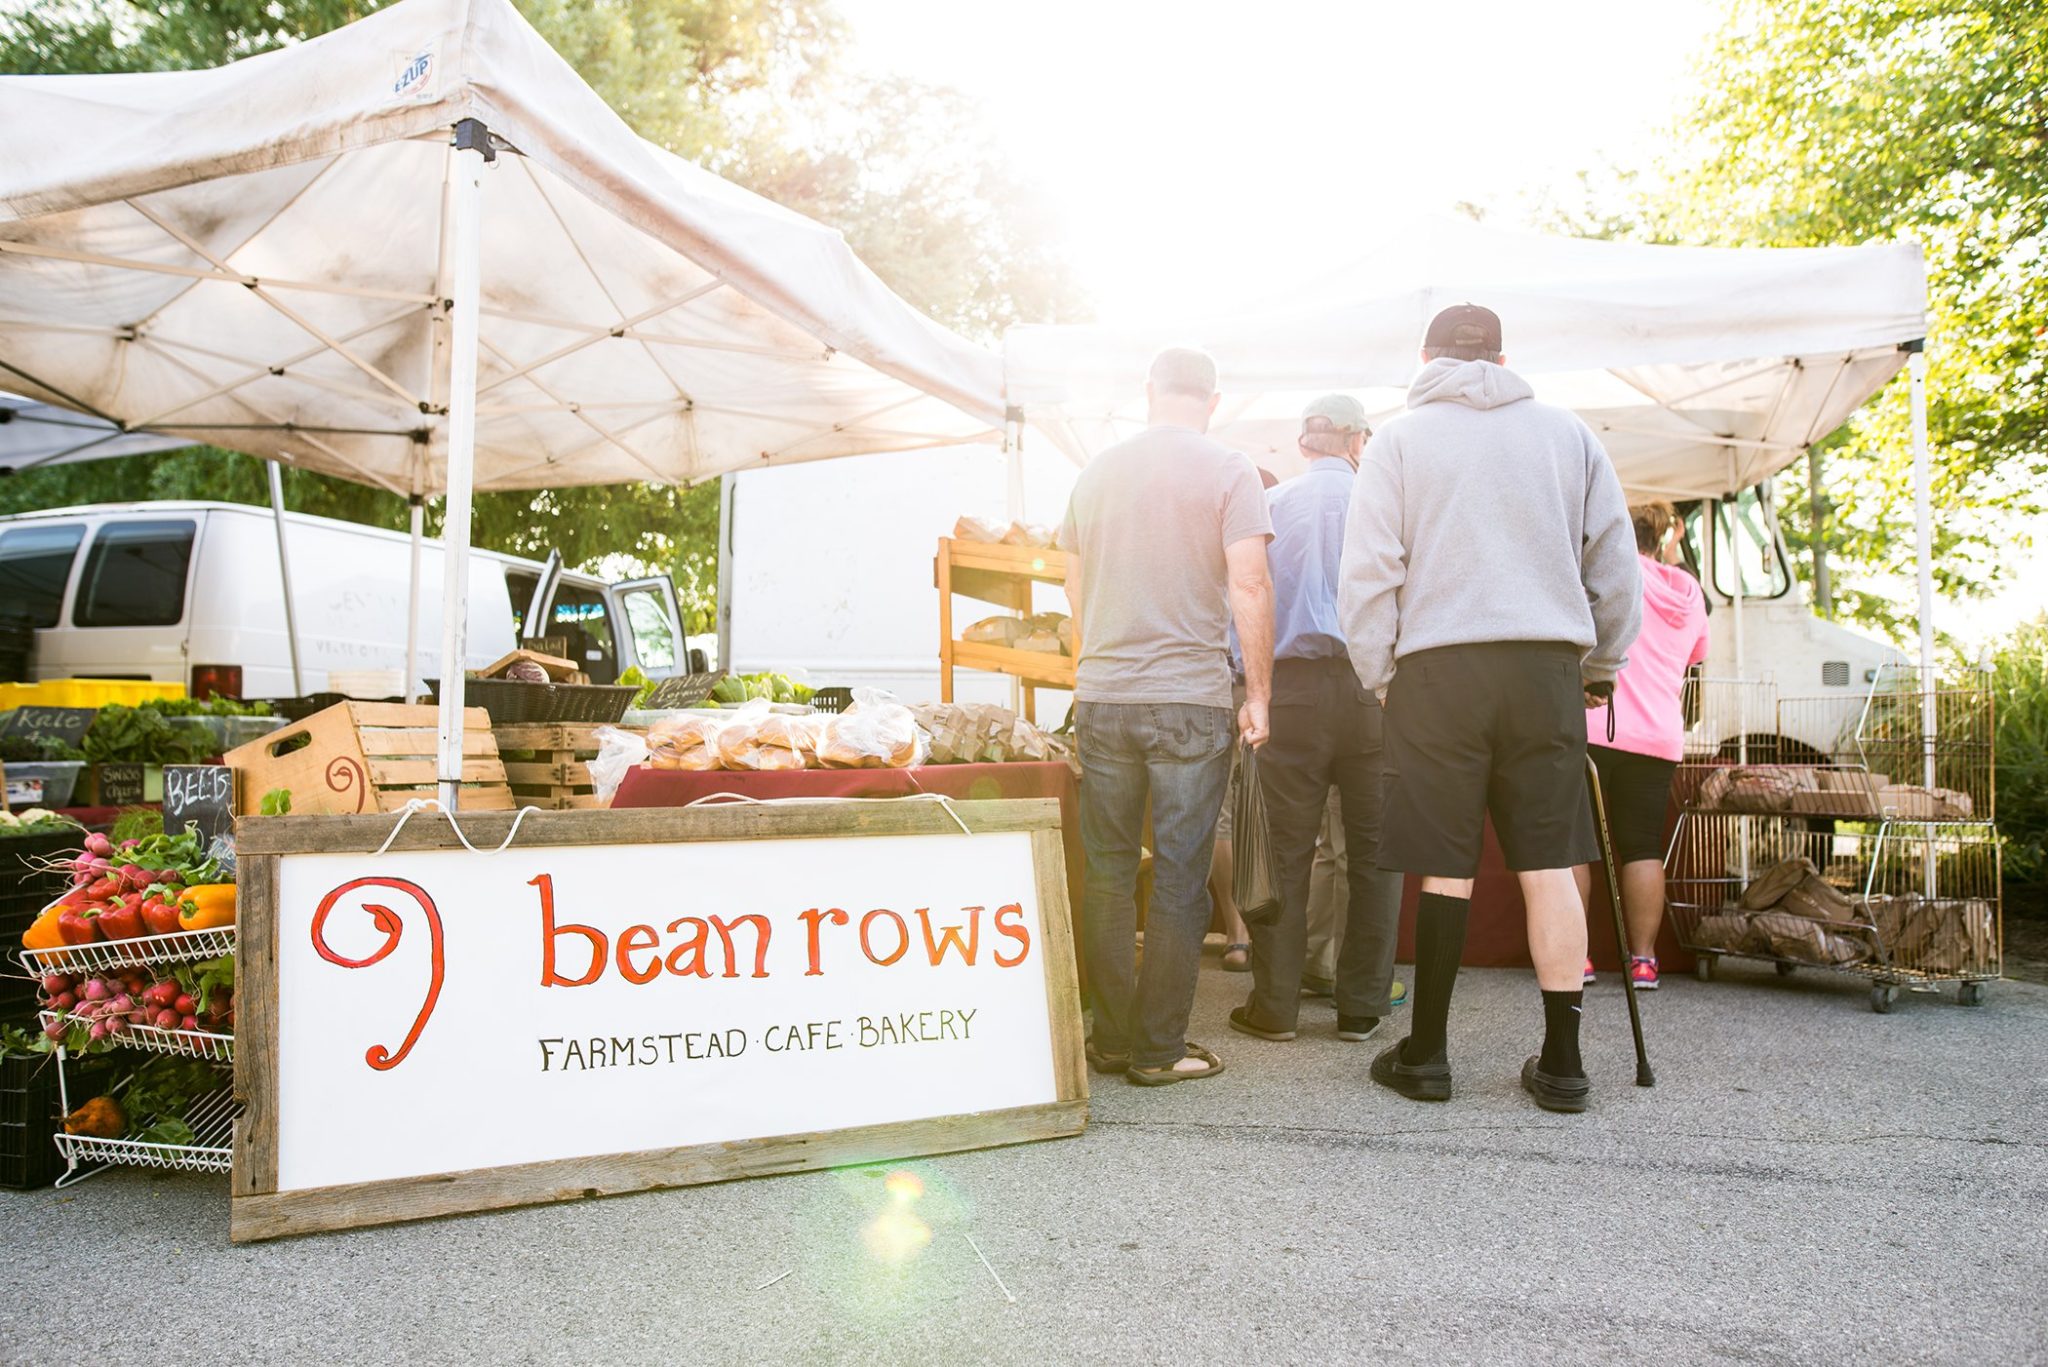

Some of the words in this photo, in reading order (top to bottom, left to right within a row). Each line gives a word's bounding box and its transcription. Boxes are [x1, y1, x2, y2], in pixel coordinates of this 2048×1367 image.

[17, 709, 82, 729] Kale
[527, 873, 772, 988] bean
[799, 903, 1031, 980] rows
[539, 1028, 747, 1072] FARMSTEAD
[765, 1021, 844, 1052] CAFE
[857, 1008, 978, 1050] BAKERY
